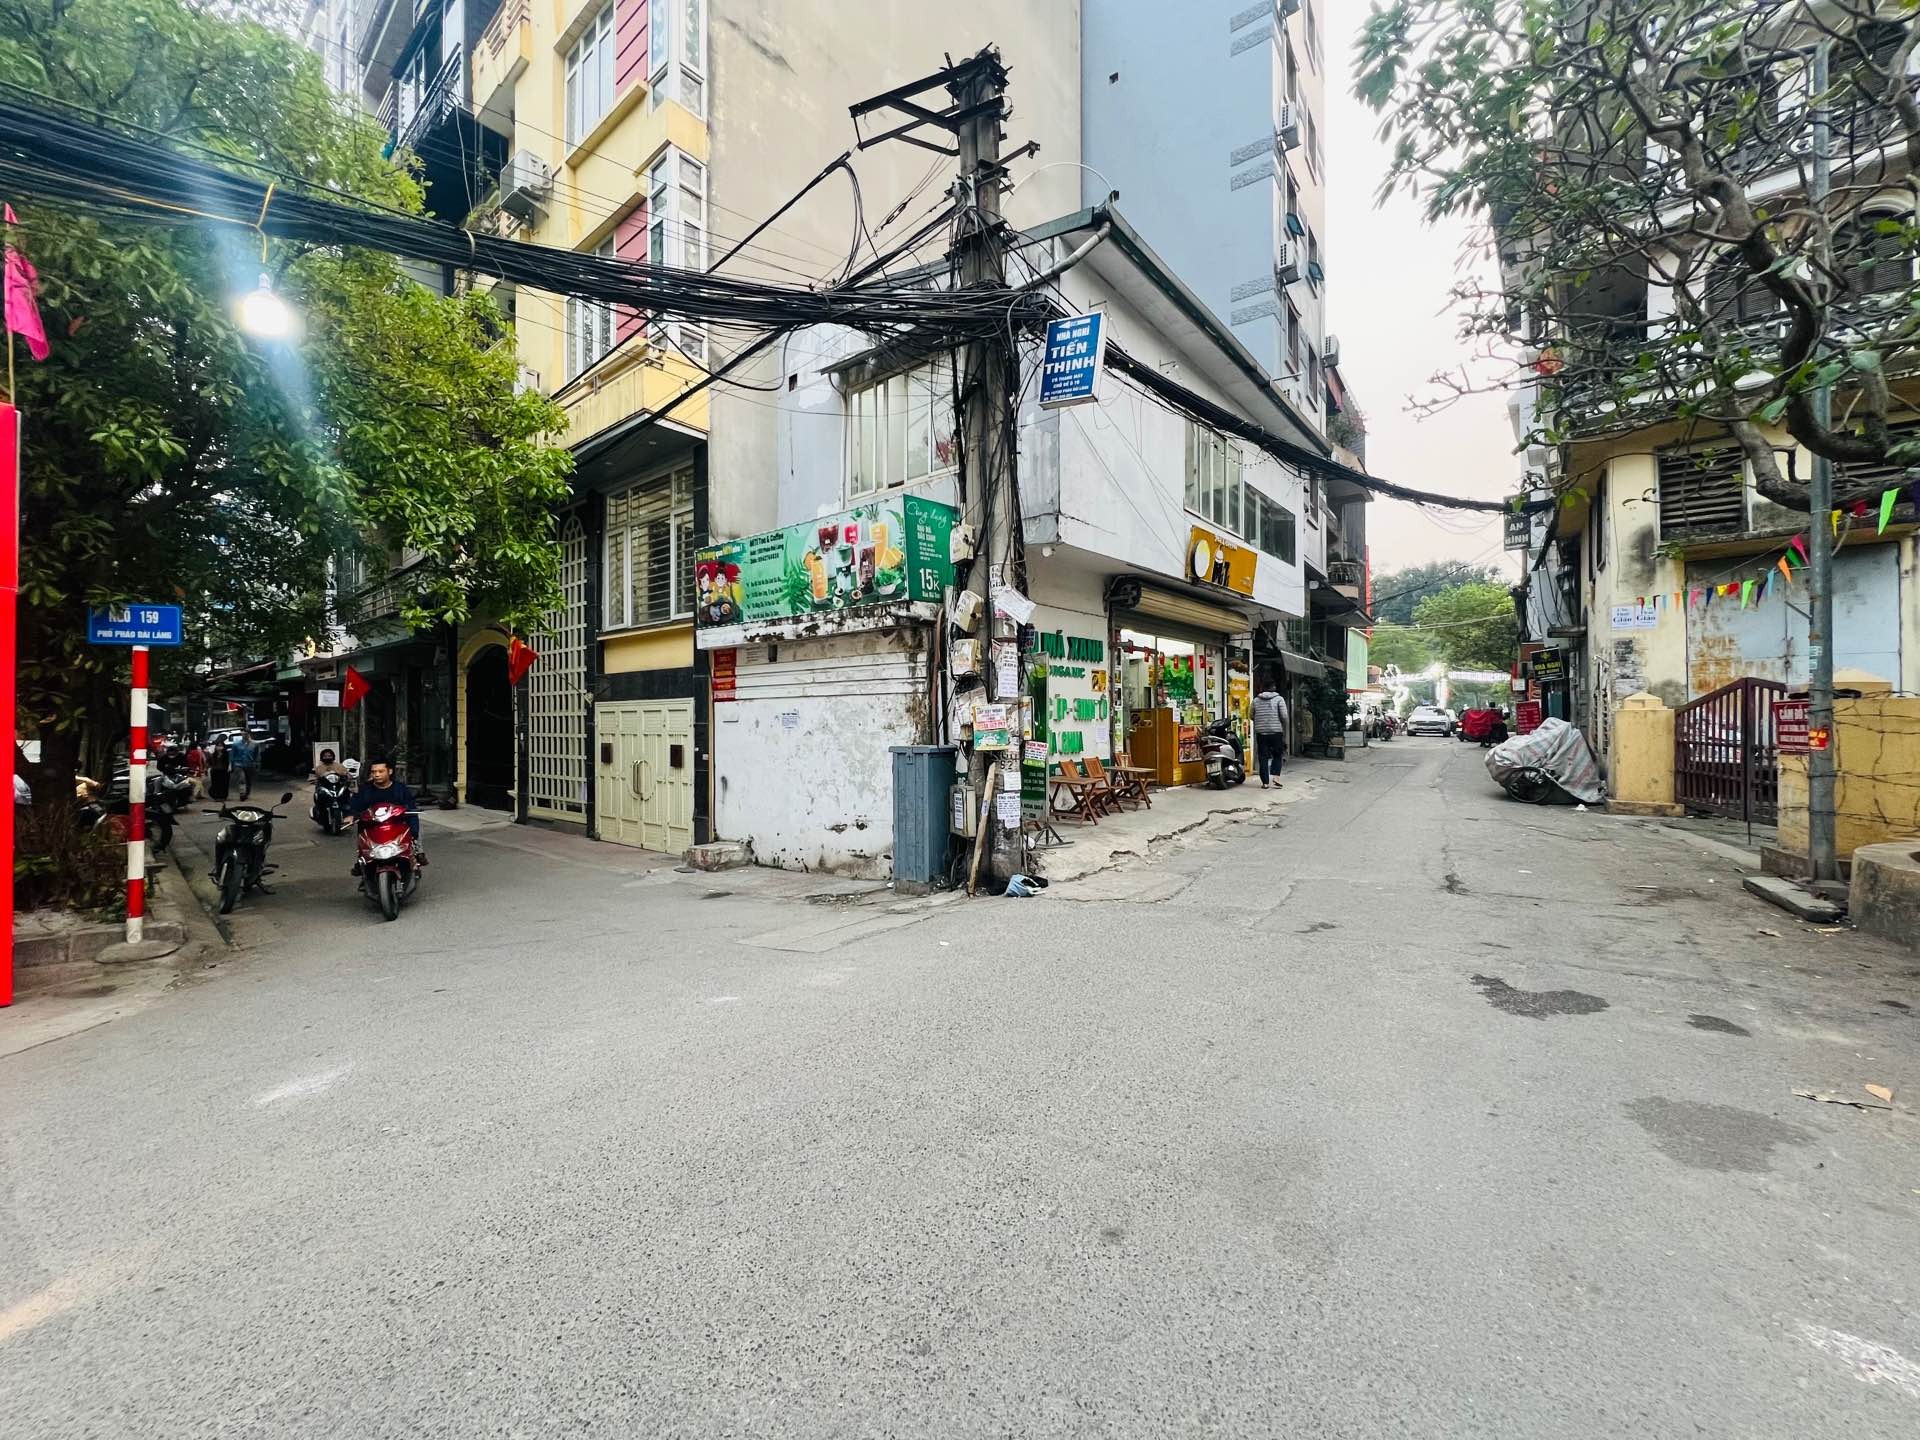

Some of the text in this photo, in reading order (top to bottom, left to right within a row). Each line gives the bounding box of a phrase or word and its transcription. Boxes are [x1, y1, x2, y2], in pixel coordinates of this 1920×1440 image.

[1056, 330, 1071, 342] NHÀ
[1051, 339, 1088, 359] TIẾN
[1045, 355, 1095, 375] THỊNH
[1509, 522, 1524, 531] AN
[140, 610, 159, 624] 159
[1041, 630, 1065, 659] MÁ
[1067, 636, 1103, 663] XANH
